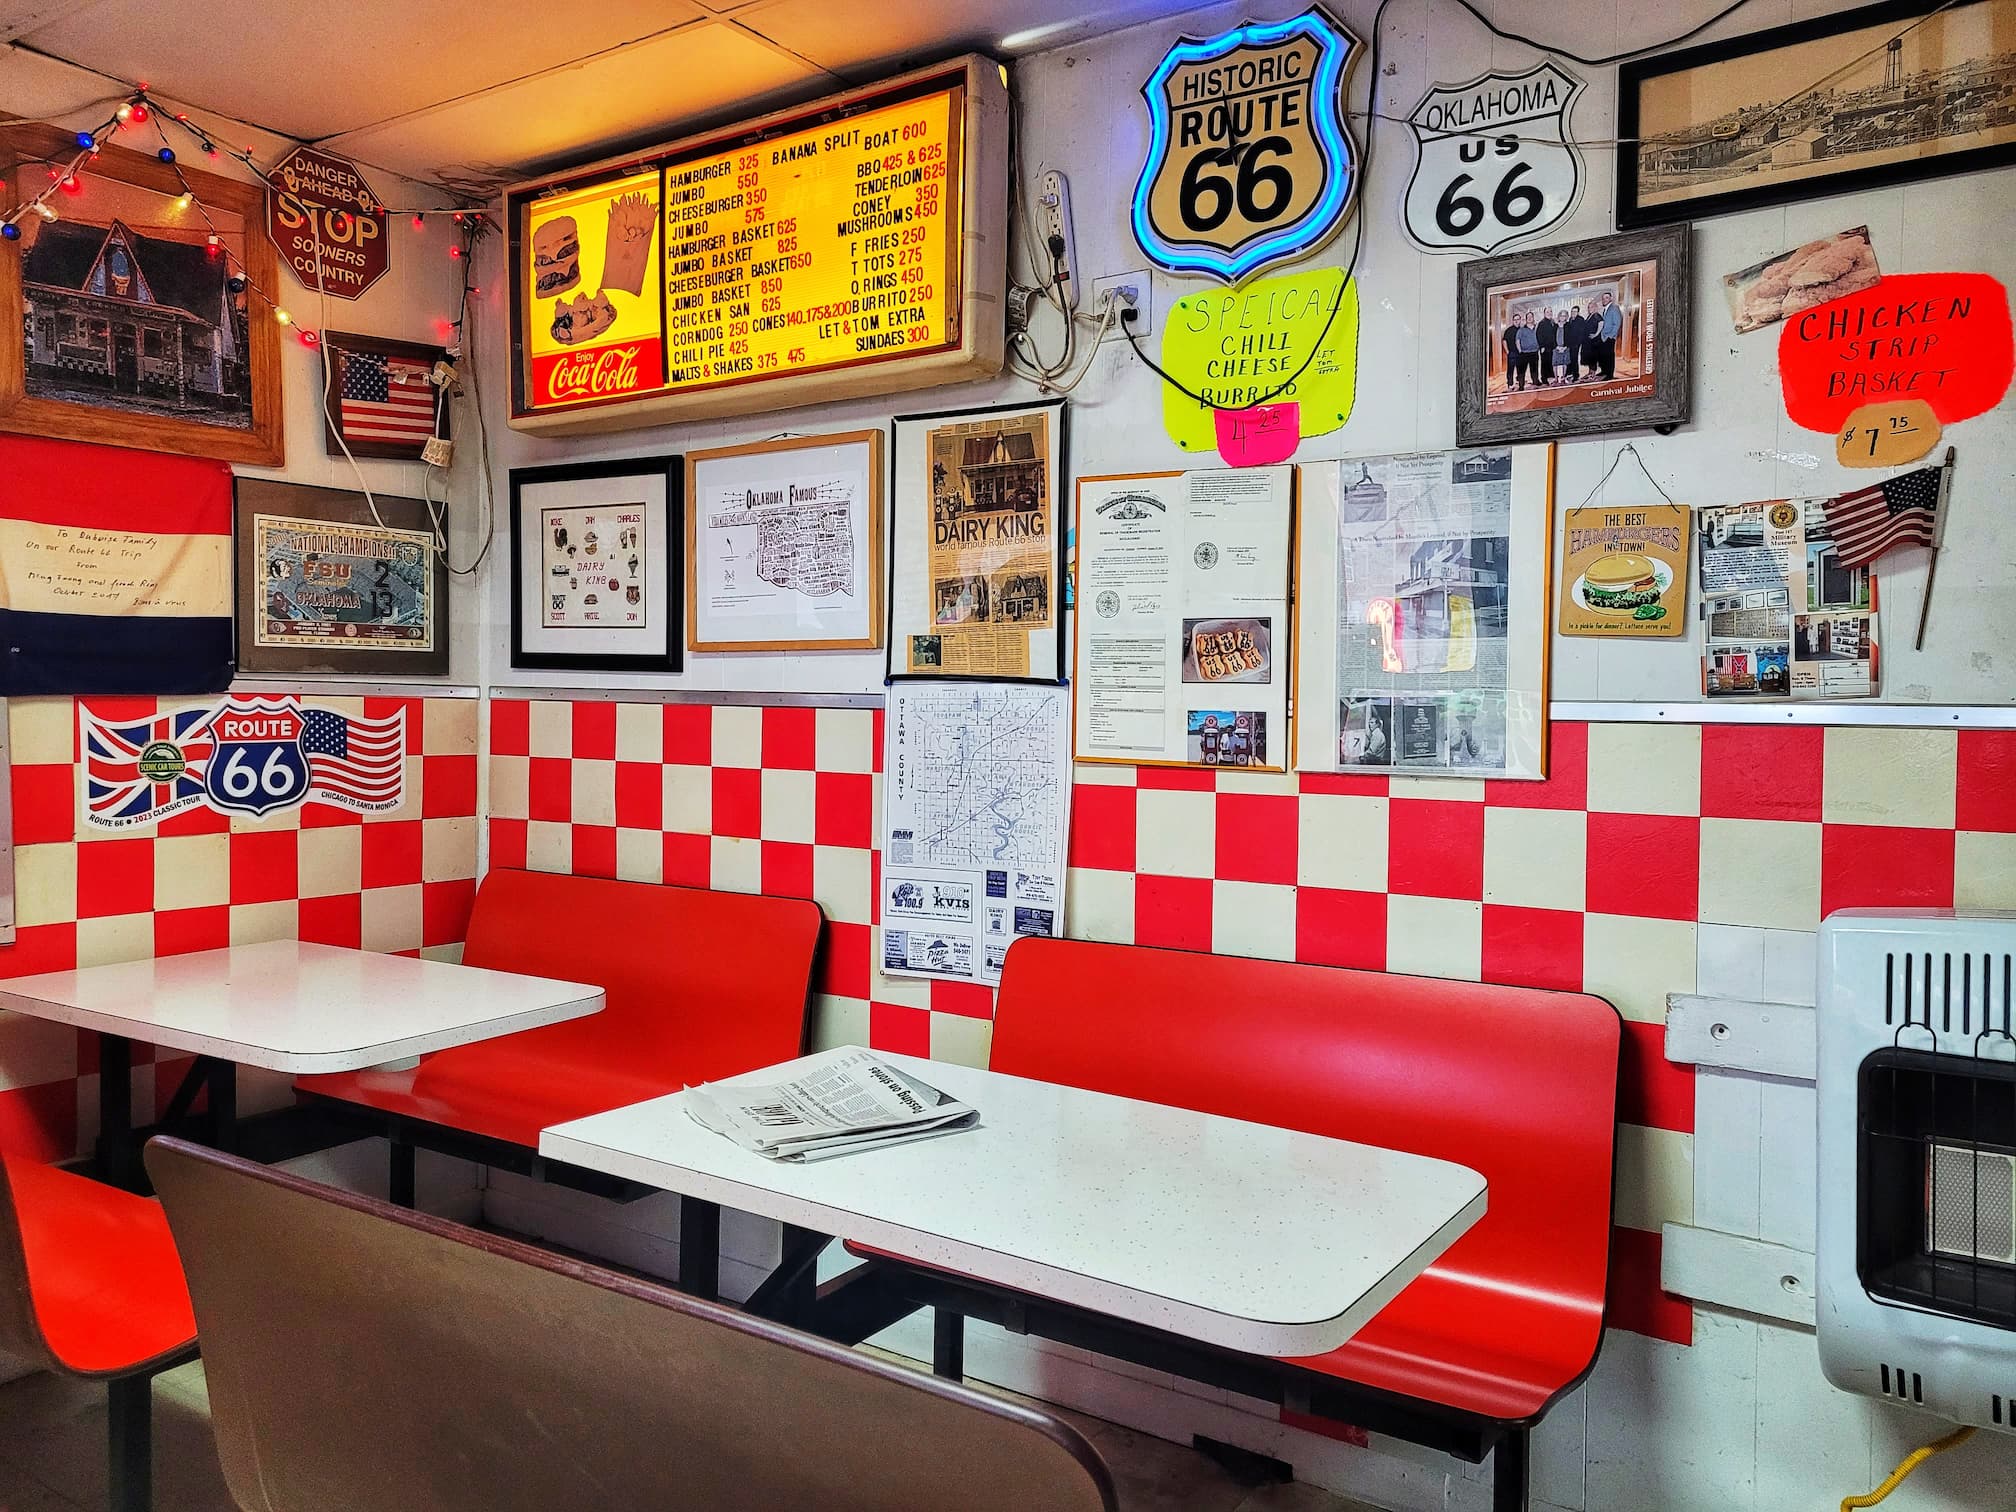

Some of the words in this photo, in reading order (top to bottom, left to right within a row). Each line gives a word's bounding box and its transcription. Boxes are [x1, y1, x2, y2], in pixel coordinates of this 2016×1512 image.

[1183, 51, 1301, 99] HISTORIC
[1180, 90, 1301, 147] ROUTE
[1425, 79, 1557, 131] OKLAHOMA
[670, 161, 731, 188] HAMBURGER
[739, 154, 759, 171] 325
[772, 141, 818, 165] BANANA
[825, 130, 860, 151] SPLIT
[864, 128, 899, 151] BOAT
[902, 121, 927, 141] 600
[857, 160, 881, 178] BBQ
[882, 153, 903, 171] 425
[907, 150, 916, 164] &
[919, 143, 942, 161] 625
[296, 157, 357, 188] DANGER
[855, 168, 922, 198] TENDERLOIN
[923, 161, 946, 179] 625
[1179, 136, 1293, 232] 66
[302, 177, 352, 201] AHEAD
[670, 188, 705, 206] JUMBO
[737, 172, 758, 189] 550
[853, 195, 891, 217] CONEY
[915, 183, 939, 202] 350
[1436, 162, 1544, 237] 66
[278, 192, 378, 247] STOP
[669, 193, 743, 225] CHEESEBURGER
[746, 188, 767, 205] 350
[837, 209, 913, 238] MUSHROOMS
[914, 200, 938, 219] 450
[668, 235, 726, 259] HAMBURGER
[732, 222, 775, 246] BASKET
[777, 218, 797, 235] 625
[672, 220, 708, 241] JUMBO
[745, 207, 765, 224] 575
[292, 236, 366, 266] SOONERS
[671, 257, 704, 277] JUMBO
[712, 246, 753, 268] BASKET
[777, 236, 797, 254] 825
[851, 242, 857, 257] F
[865, 232, 899, 255] FRIES
[902, 226, 926, 245] 250
[294, 257, 364, 285] COUNTRY
[669, 267, 743, 295] CHEESEBURGER
[751, 257, 791, 277] BASKET
[790, 252, 812, 270] 650
[852, 261, 858, 275] T
[864, 253, 895, 273] TOTS
[898, 247, 922, 266] 275
[672, 294, 703, 312] JUMBO
[712, 284, 750, 305] BASKET
[761, 277, 783, 295] 850
[863, 274, 897, 294] RINGS
[900, 266, 924, 285] 450
[672, 309, 721, 330] CHICKEN
[729, 302, 750, 318] SAN
[761, 296, 781, 313] 625
[673, 326, 723, 347] CORNDOG
[729, 321, 749, 338] 250
[752, 314, 785, 333] CONES
[852, 290, 907, 314] BURRITO
[909, 284, 933, 304] 250
[819, 322, 841, 340] LET
[843, 319, 850, 333] &
[852, 314, 879, 334] TOM
[888, 306, 925, 327] EXTRA
[1800, 298, 1971, 341] CHICKEN
[576, 353, 594, 362] Enjoy
[674, 346, 703, 365] CHILI
[709, 343, 724, 359] PIE
[729, 339, 749, 355] 425
[856, 330, 904, 352] SUNDAES
[907, 325, 929, 343] 300
[1222, 332, 1292, 355] CHILI
[1317, 350, 1335, 358] LET
[1840, 335, 1938, 360] STRIP
[548, 347, 640, 398] Coca-Cola
[672, 364, 701, 383] MALTS
[703, 363, 711, 377] &
[713, 356, 753, 376] SHAKES
[757, 350, 778, 368] 375
[787, 347, 806, 364] 475
[1208, 356, 1291, 378] CHEESE
[1200, 382, 1297, 409] BURRITO
[1591, 387, 1622, 397] Carnival
[1625, 384, 1653, 395] Jubilee
[1828, 369, 1958, 398] BASKET
[1232, 419, 1246, 454] 4
[1260, 410, 1279, 427] 25
[746, 489, 784, 509] OKLAHOMA
[789, 484, 817, 506] FAMOUS
[617, 515, 640, 523] CHARLES
[935, 517, 991, 544] DAIRY
[996, 512, 1045, 538] KING
[1605, 514, 1620, 526] THE
[1625, 513, 1647, 526] BEST
[68, 545, 95, 556] Route
[121, 550, 142, 560] Trip
[291, 535, 335, 554] NATIONAL
[935, 540, 956, 551] world
[957, 539, 987, 550] famous
[989, 535, 1013, 546] Route
[1014, 535, 1026, 544] 66
[1027, 534, 1046, 546] stop
[1570, 527, 1680, 555] HAMBURGERS
[1620, 542, 1645, 552] TOWN!
[303, 561, 352, 579] FSU
[375, 561, 389, 587] 2
[577, 562, 605, 572] DAIRY
[296, 591, 361, 609] OKLAHOMA
[371, 591, 393, 617] 13
[224, 720, 292, 737] ROUTE
[898, 698, 906, 745] OTTAWA
[140, 763, 157, 771] SCENIC
[223, 746, 295, 797] 66
[898, 754, 906, 800] COUNTY
[89, 814, 114, 827] ROUTE
[115, 819, 124, 827] 66
[153, 802, 182, 817] CLASSIC
[182, 796, 201, 808] TOUR
[321, 791, 348, 803] CHICAGO
[356, 800, 374, 809] SANTA
[375, 799, 399, 810] MONICA
[904, 897, 924, 909] 100.9
[927, 949, 949, 961] Pizza
[868, 1066, 894, 1085] stories
[888, 1083, 902, 1094] on
[897, 1090, 926, 1114] Passing
